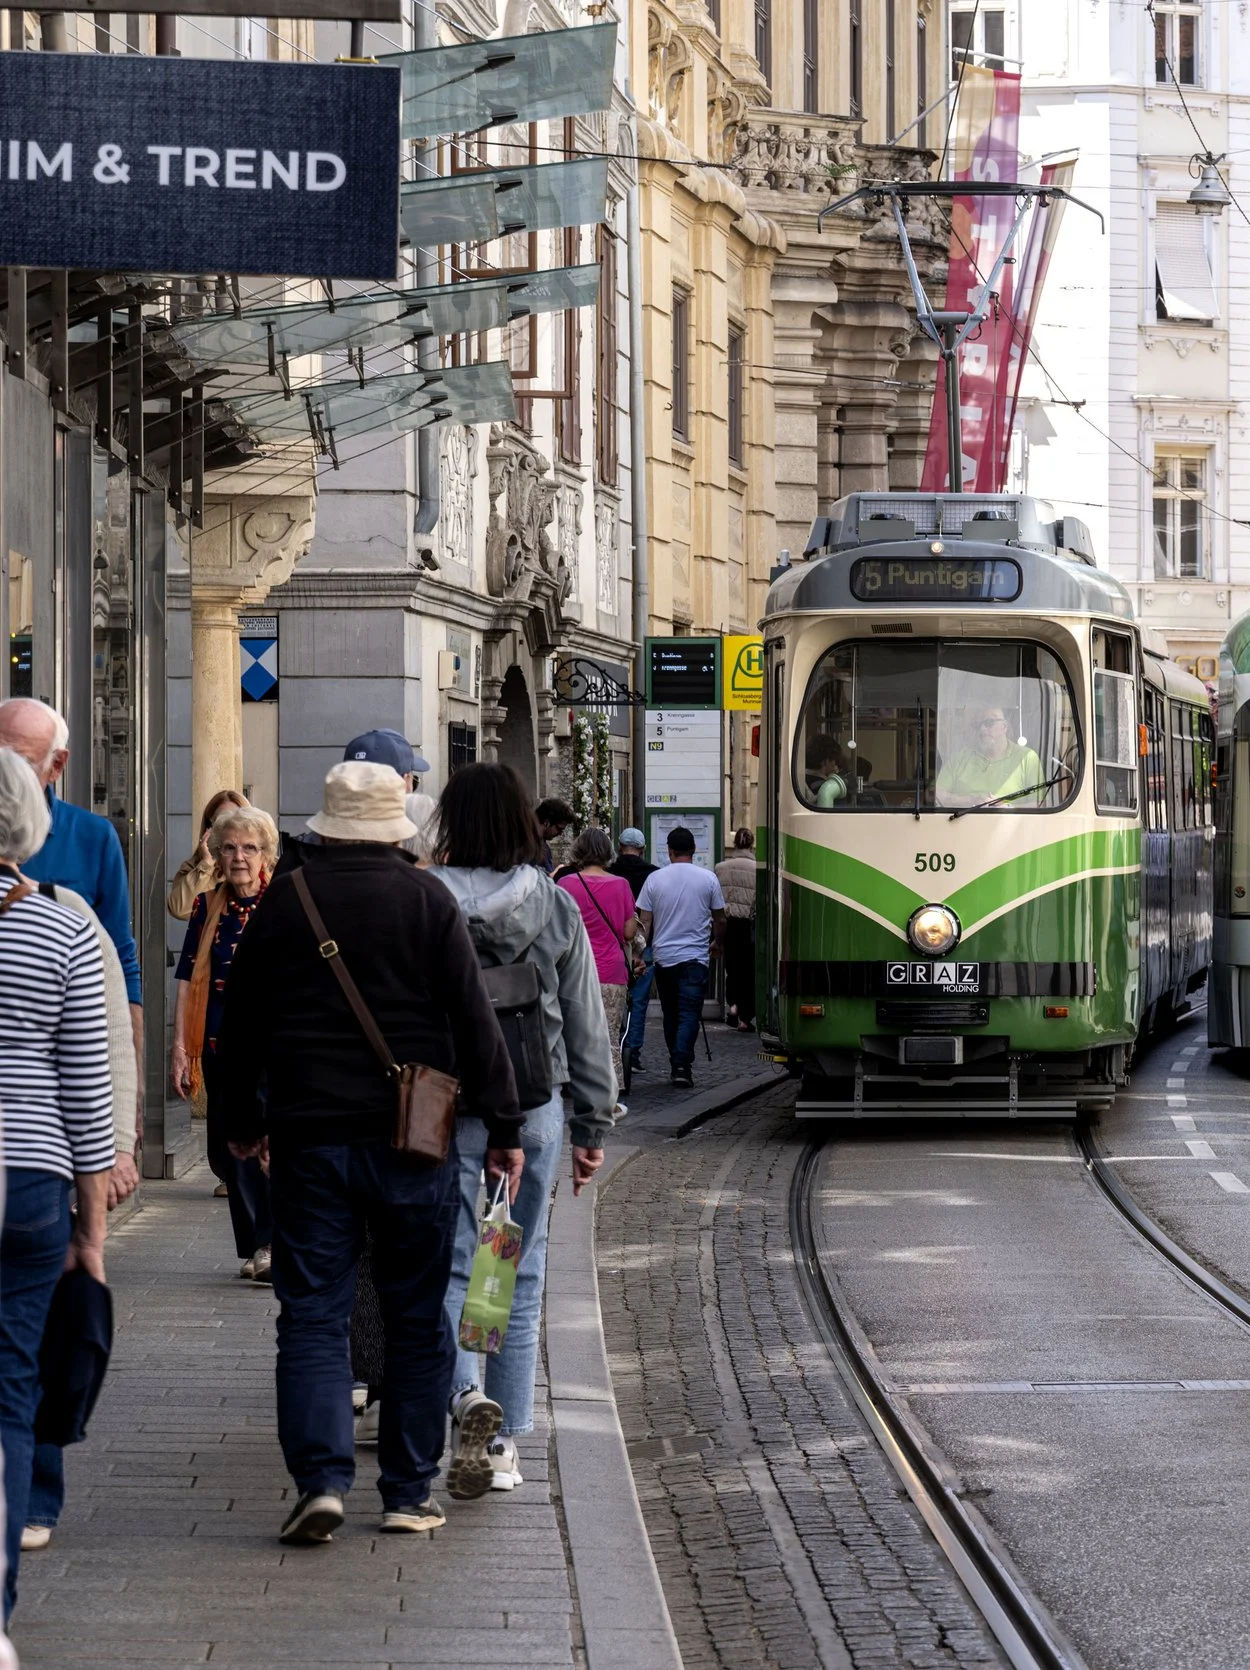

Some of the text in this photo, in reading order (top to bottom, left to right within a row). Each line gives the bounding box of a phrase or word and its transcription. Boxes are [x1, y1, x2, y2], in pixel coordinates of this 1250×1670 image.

[0, 140, 347, 192] IM & TREND
[865, 560, 1004, 590] 5 Puntigam
[656, 712, 663, 722] 3
[656, 726, 663, 736] 5
[650, 742, 663, 750] N9
[914, 853, 956, 872] 509
[888, 963, 978, 983] GRAZ
[943, 985, 979, 993] HOLDING
